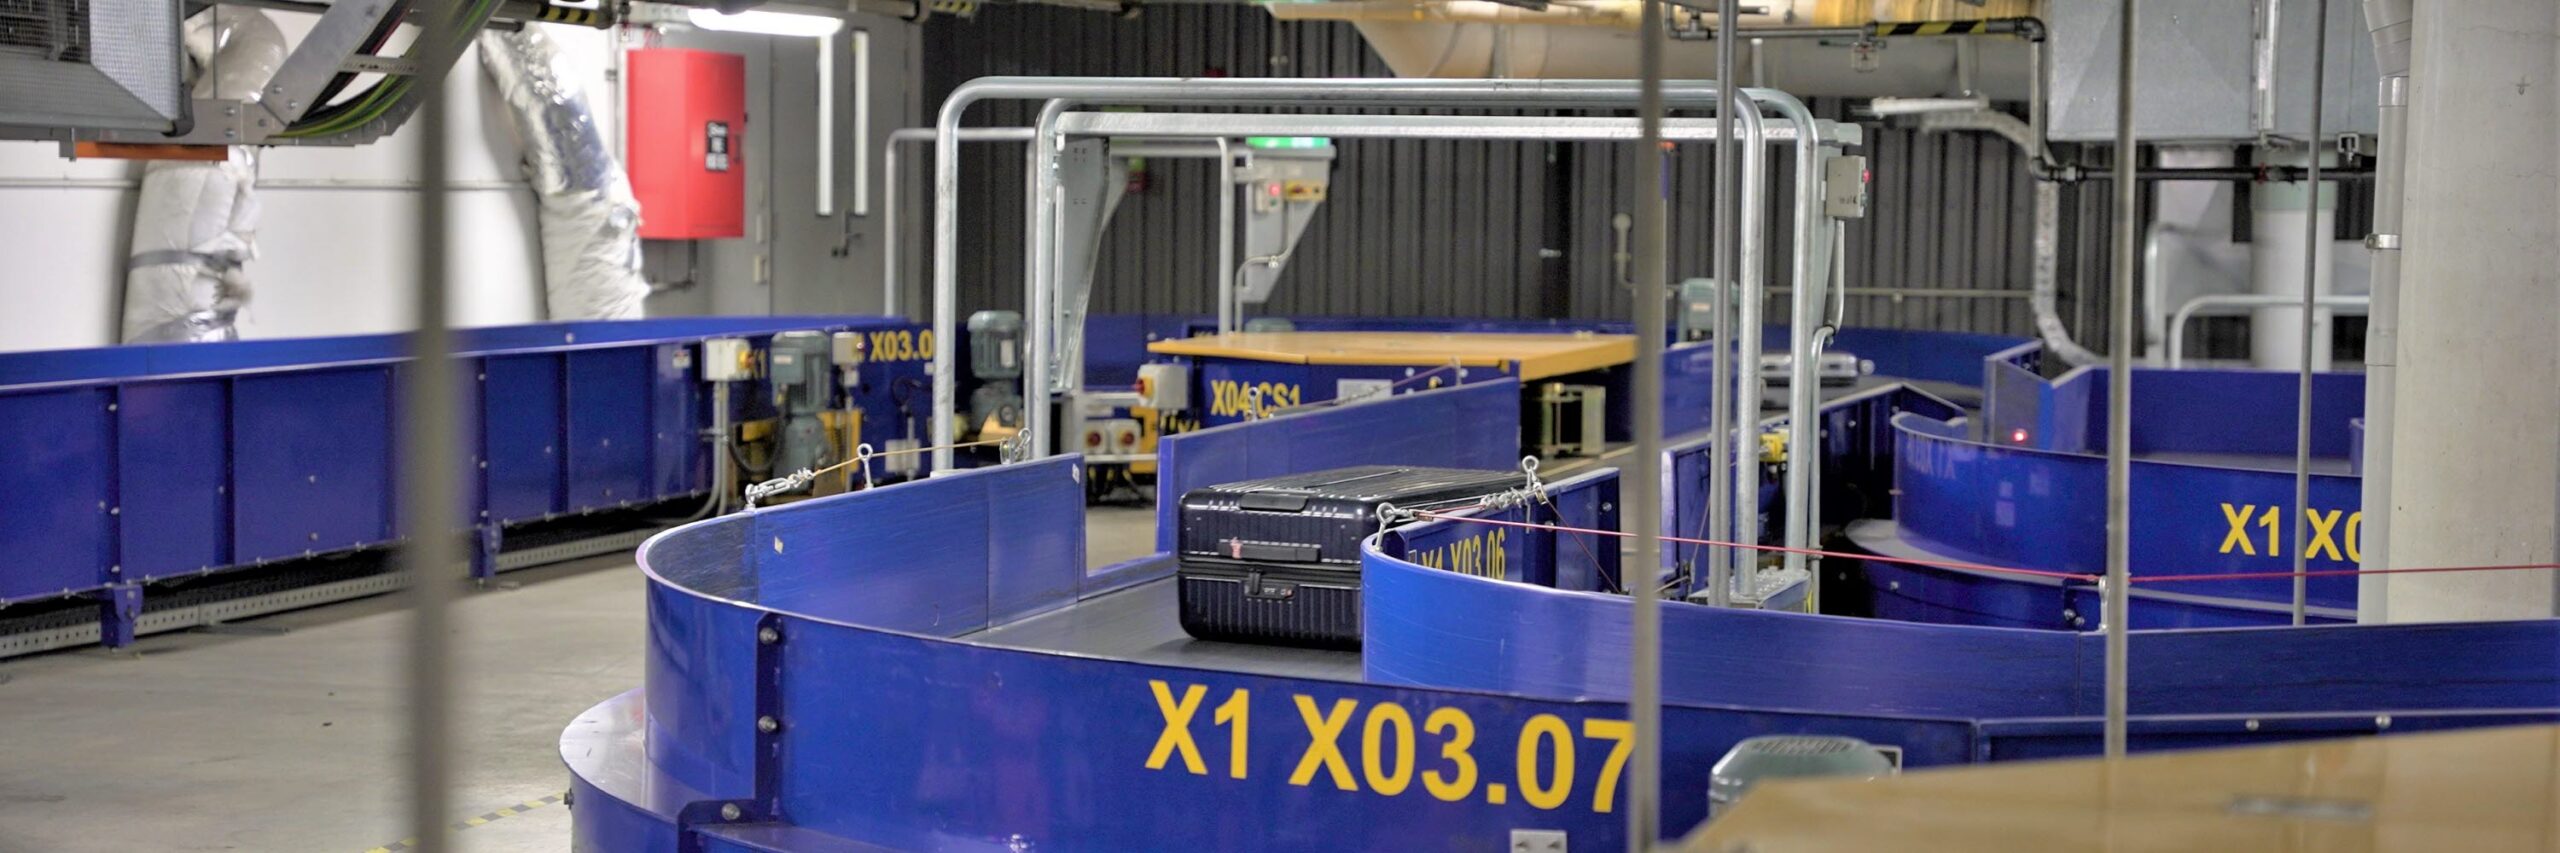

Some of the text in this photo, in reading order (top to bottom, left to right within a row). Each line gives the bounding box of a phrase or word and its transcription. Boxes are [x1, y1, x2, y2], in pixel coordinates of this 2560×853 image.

[1211, 379, 1300, 418] X04CS1
[2219, 503, 2280, 557] X1
[1145, 680, 1637, 813] X1 X03.07
